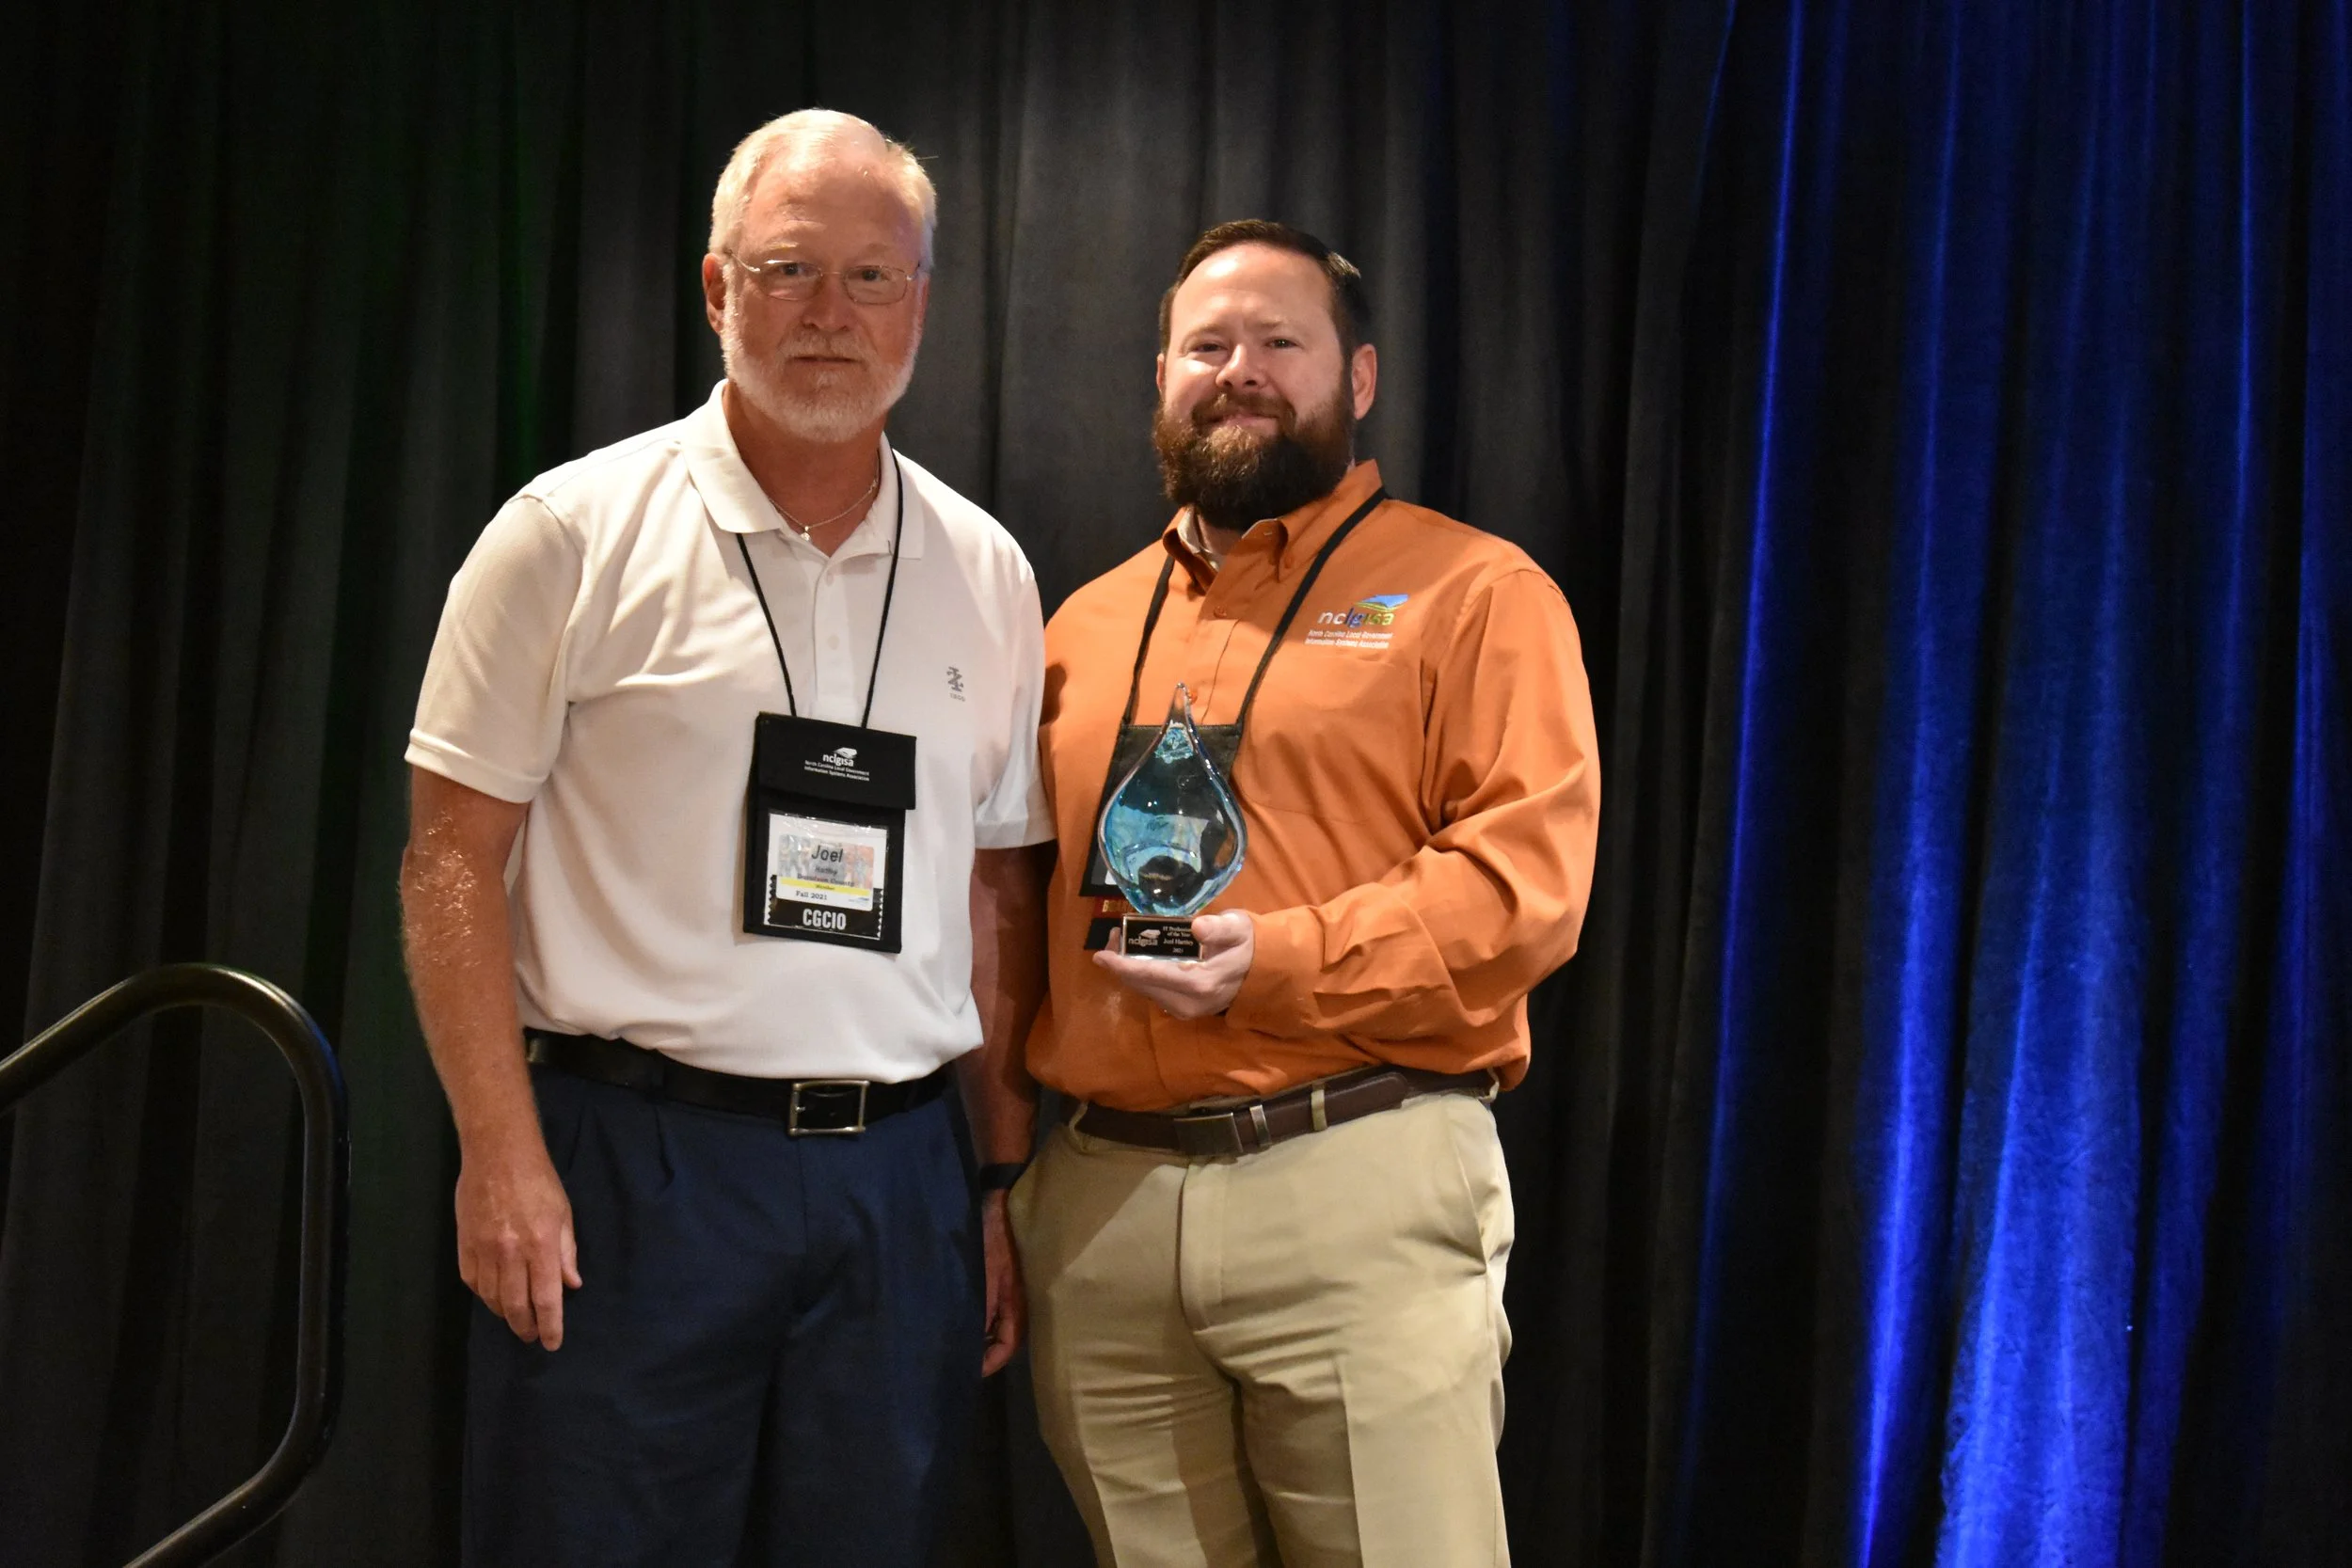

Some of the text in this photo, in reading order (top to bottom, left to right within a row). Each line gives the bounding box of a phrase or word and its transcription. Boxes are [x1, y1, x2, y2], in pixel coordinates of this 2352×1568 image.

[1317, 607, 1394, 628] nclgisa
[822, 753, 854, 767] nclgisa
[811, 846, 844, 863] Joel
[795, 890, 809, 898] Fall
[803, 908, 847, 930] CGCIO
[1128, 936, 1158, 947] nclgisa
